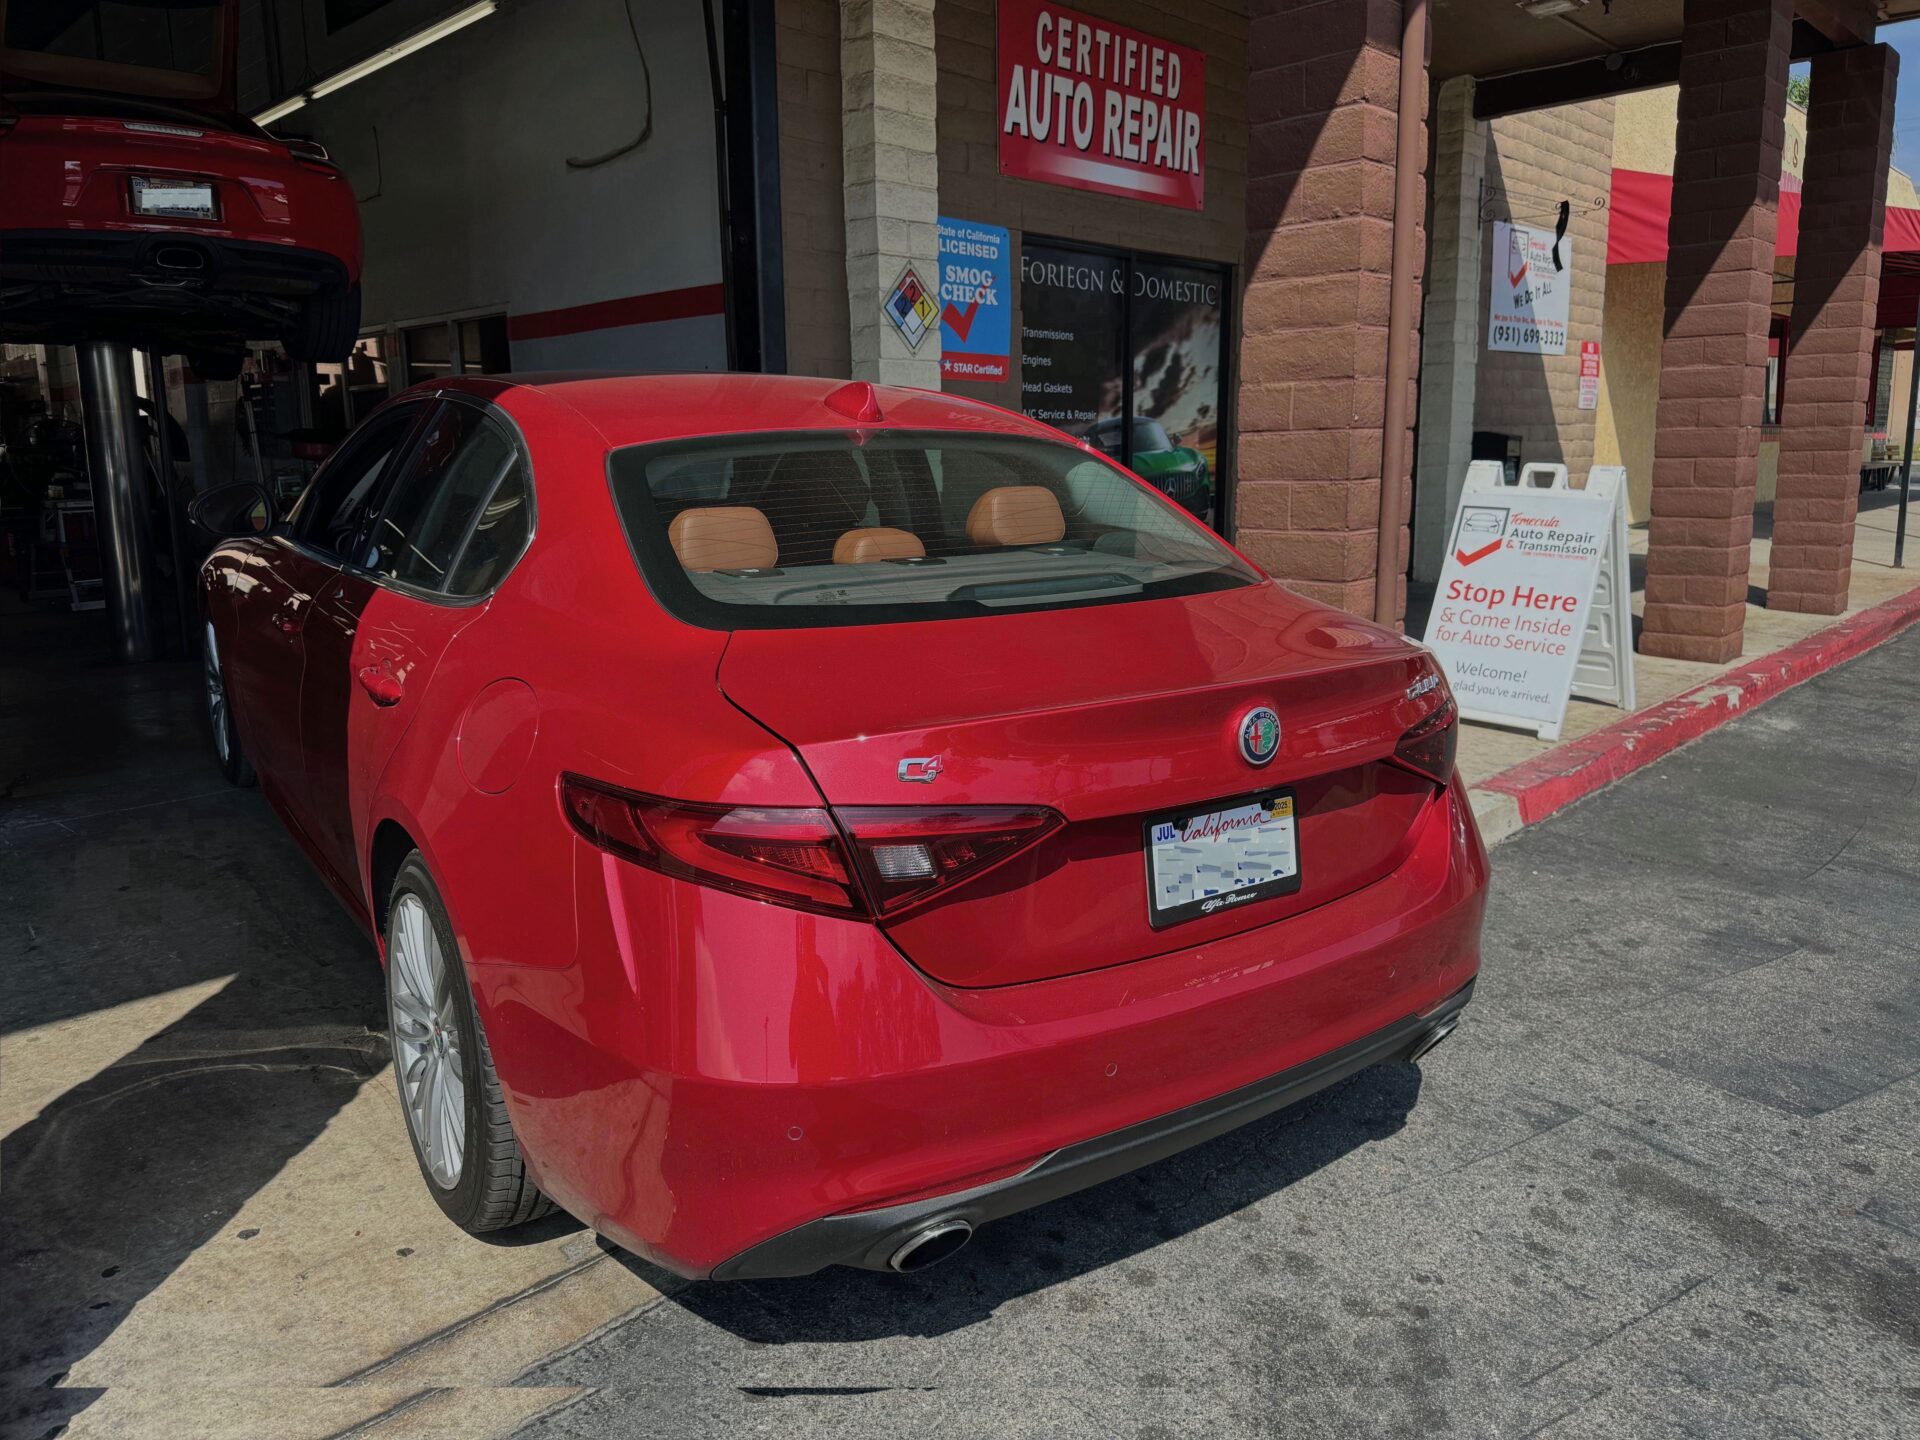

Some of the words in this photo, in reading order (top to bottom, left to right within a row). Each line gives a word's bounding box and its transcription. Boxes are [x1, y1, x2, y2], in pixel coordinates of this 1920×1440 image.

[1036, 11, 1181, 100] CERTIFIED
[1003, 64, 1095, 151] AUTO
[1102, 88, 1201, 175] REPAIR
[957, 228, 965, 238] of
[966, 229, 1001, 244] California
[938, 238, 998, 260] LICENSED
[945, 265, 993, 287] SMOG
[1021, 256, 1104, 292] FORIEGN
[1110, 269, 1124, 294] &
[909, 284, 915, 304] 2
[940, 283, 998, 306] CHECK
[920, 301, 925, 317] 1
[1022, 327, 1074, 342] Transmissions
[1493, 325, 1521, 346] (951)
[1523, 328, 1564, 346] 699-3332
[953, 362, 973, 374] STAR
[973, 363, 1003, 375] Certified
[1022, 355, 1052, 368] Engines
[1022, 382, 1042, 394] Head
[1043, 383, 1073, 395] Gaskets
[1022, 409, 1036, 419] A/C
[1038, 409, 1065, 420] Service
[1066, 409, 1073, 419] &
[1074, 410, 1097, 421] Repair
[1510, 512, 1561, 528] Temecula
[1506, 539, 1514, 549] &
[1518, 540, 1597, 556] Transmission
[1509, 528, 1544, 541] Auto
[1547, 529, 1596, 545] Repair
[1446, 579, 1505, 609] Stop
[1511, 585, 1579, 613] Here
[1440, 607, 1457, 623] &
[1459, 609, 1511, 630] Come
[1515, 614, 1572, 637] Inside
[1435, 626, 1459, 643] for
[1459, 629, 1500, 648] Auto
[1503, 634, 1566, 657] Service
[1455, 660, 1528, 684] Welcome!
[1452, 680, 1475, 694] glad
[1475, 683, 1508, 700] you've
[1509, 690, 1551, 705] arrived.
[1245, 716, 1257, 740] ALFA
[1259, 712, 1279, 735] ROMEO
[897, 754, 943, 784] Q4
[1274, 801, 1288, 810] 2025
[1156, 825, 1176, 842] JUL
[1180, 811, 1271, 844] California
[1201, 897, 1225, 913] Alfa
[1225, 891, 1258, 904] Romeo
